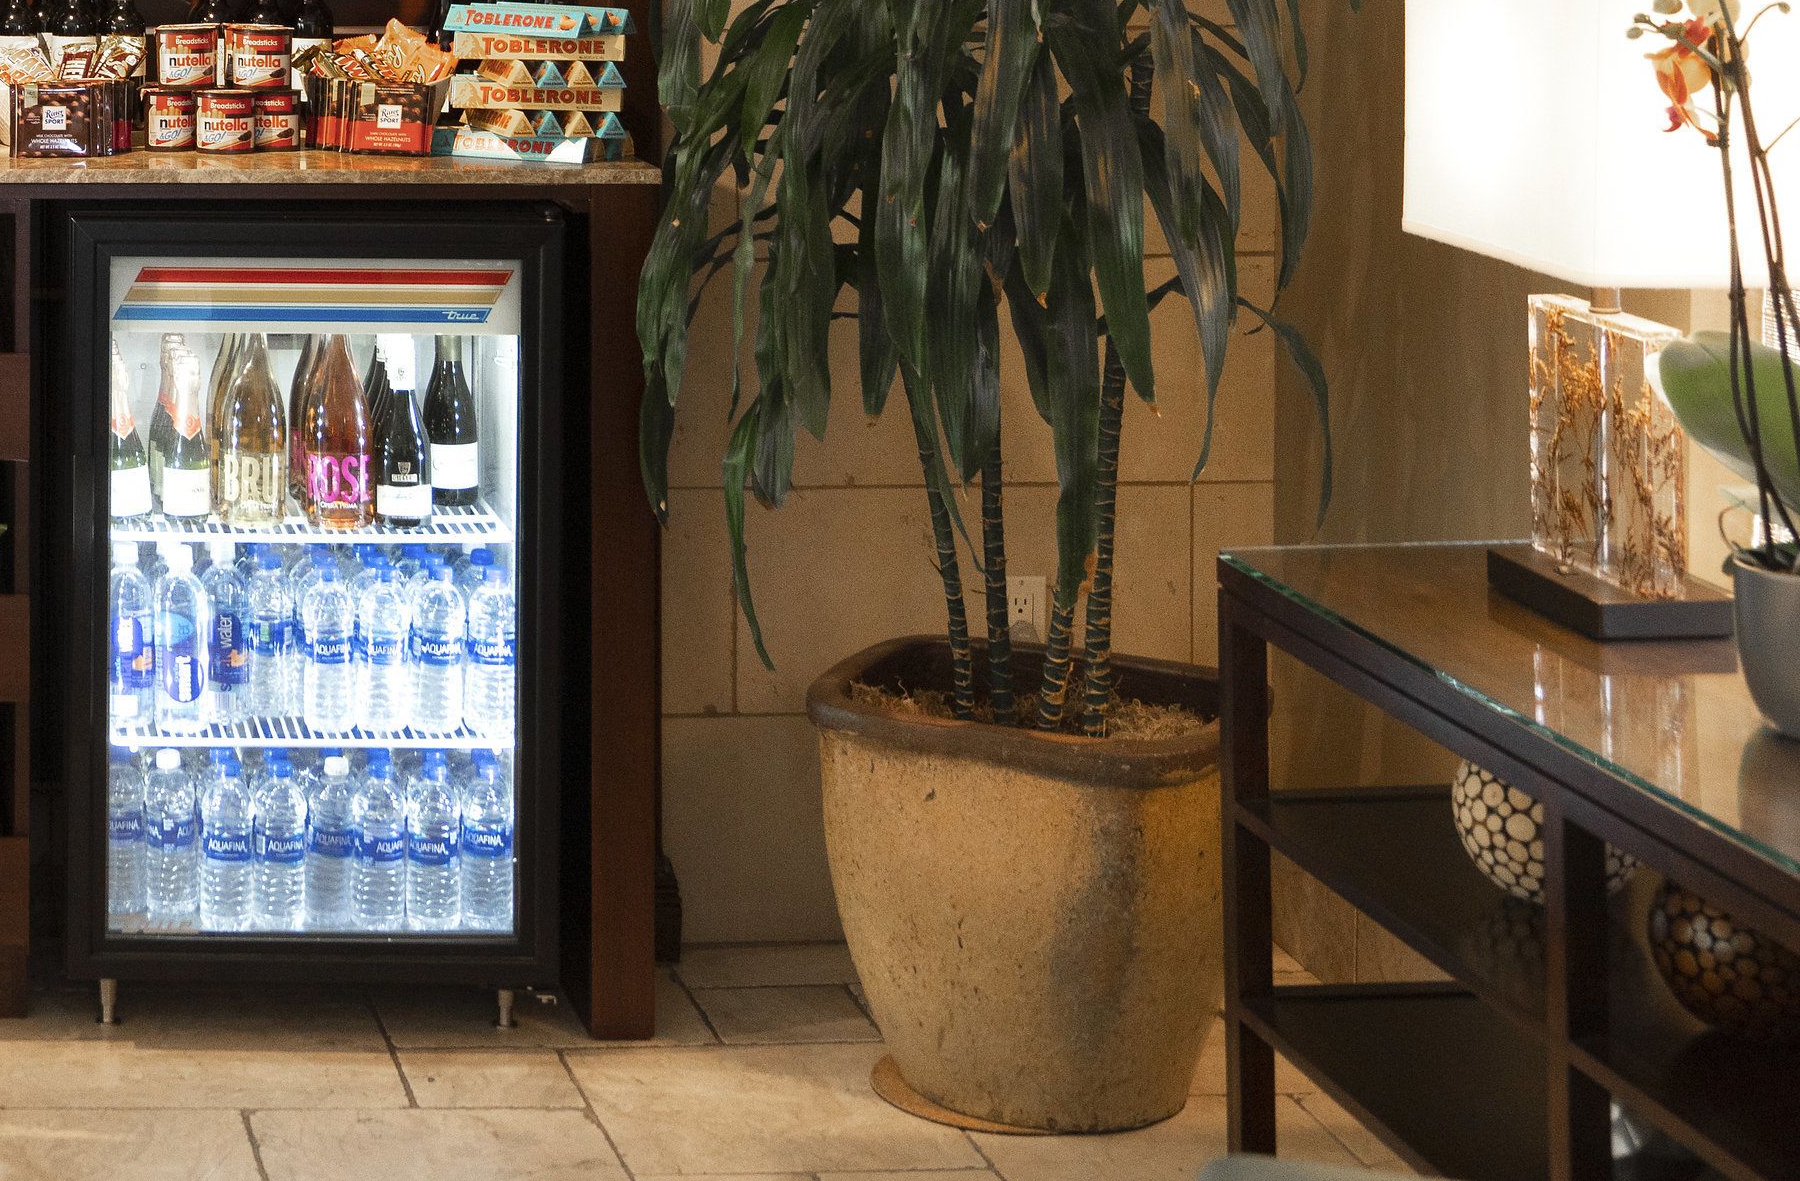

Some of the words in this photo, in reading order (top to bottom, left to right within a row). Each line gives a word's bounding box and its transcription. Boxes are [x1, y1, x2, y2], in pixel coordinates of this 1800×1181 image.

[465, 9, 556, 29] TOBLERONE
[176, 36, 209, 45] Breadsticks
[242, 38, 278, 46] Breadsticks
[482, 36, 606, 55] TOBLERONE
[168, 54, 212, 68] nutella
[236, 54, 282, 68] nutella
[480, 86, 603, 105] TOBLERONE
[210, 100, 246, 109] Breadsticks
[159, 115, 196, 129] nutell
[204, 117, 248, 132] nutella
[254, 115, 289, 128] tella
[442, 310, 481, 321] true
[224, 454, 286, 502] BRU
[220, 614, 233, 648] water
[423, 642, 462, 655] AQUAFINA
[474, 644, 514, 656] AQUAFINA
[208, 838, 248, 852] AQUAFINA
[268, 839, 304, 851] AQUAFINA
[465, 831, 504, 846] AQUAFINA
[376, 840, 404, 854] AQUAF
[410, 840, 450, 854] AQUAFINA
